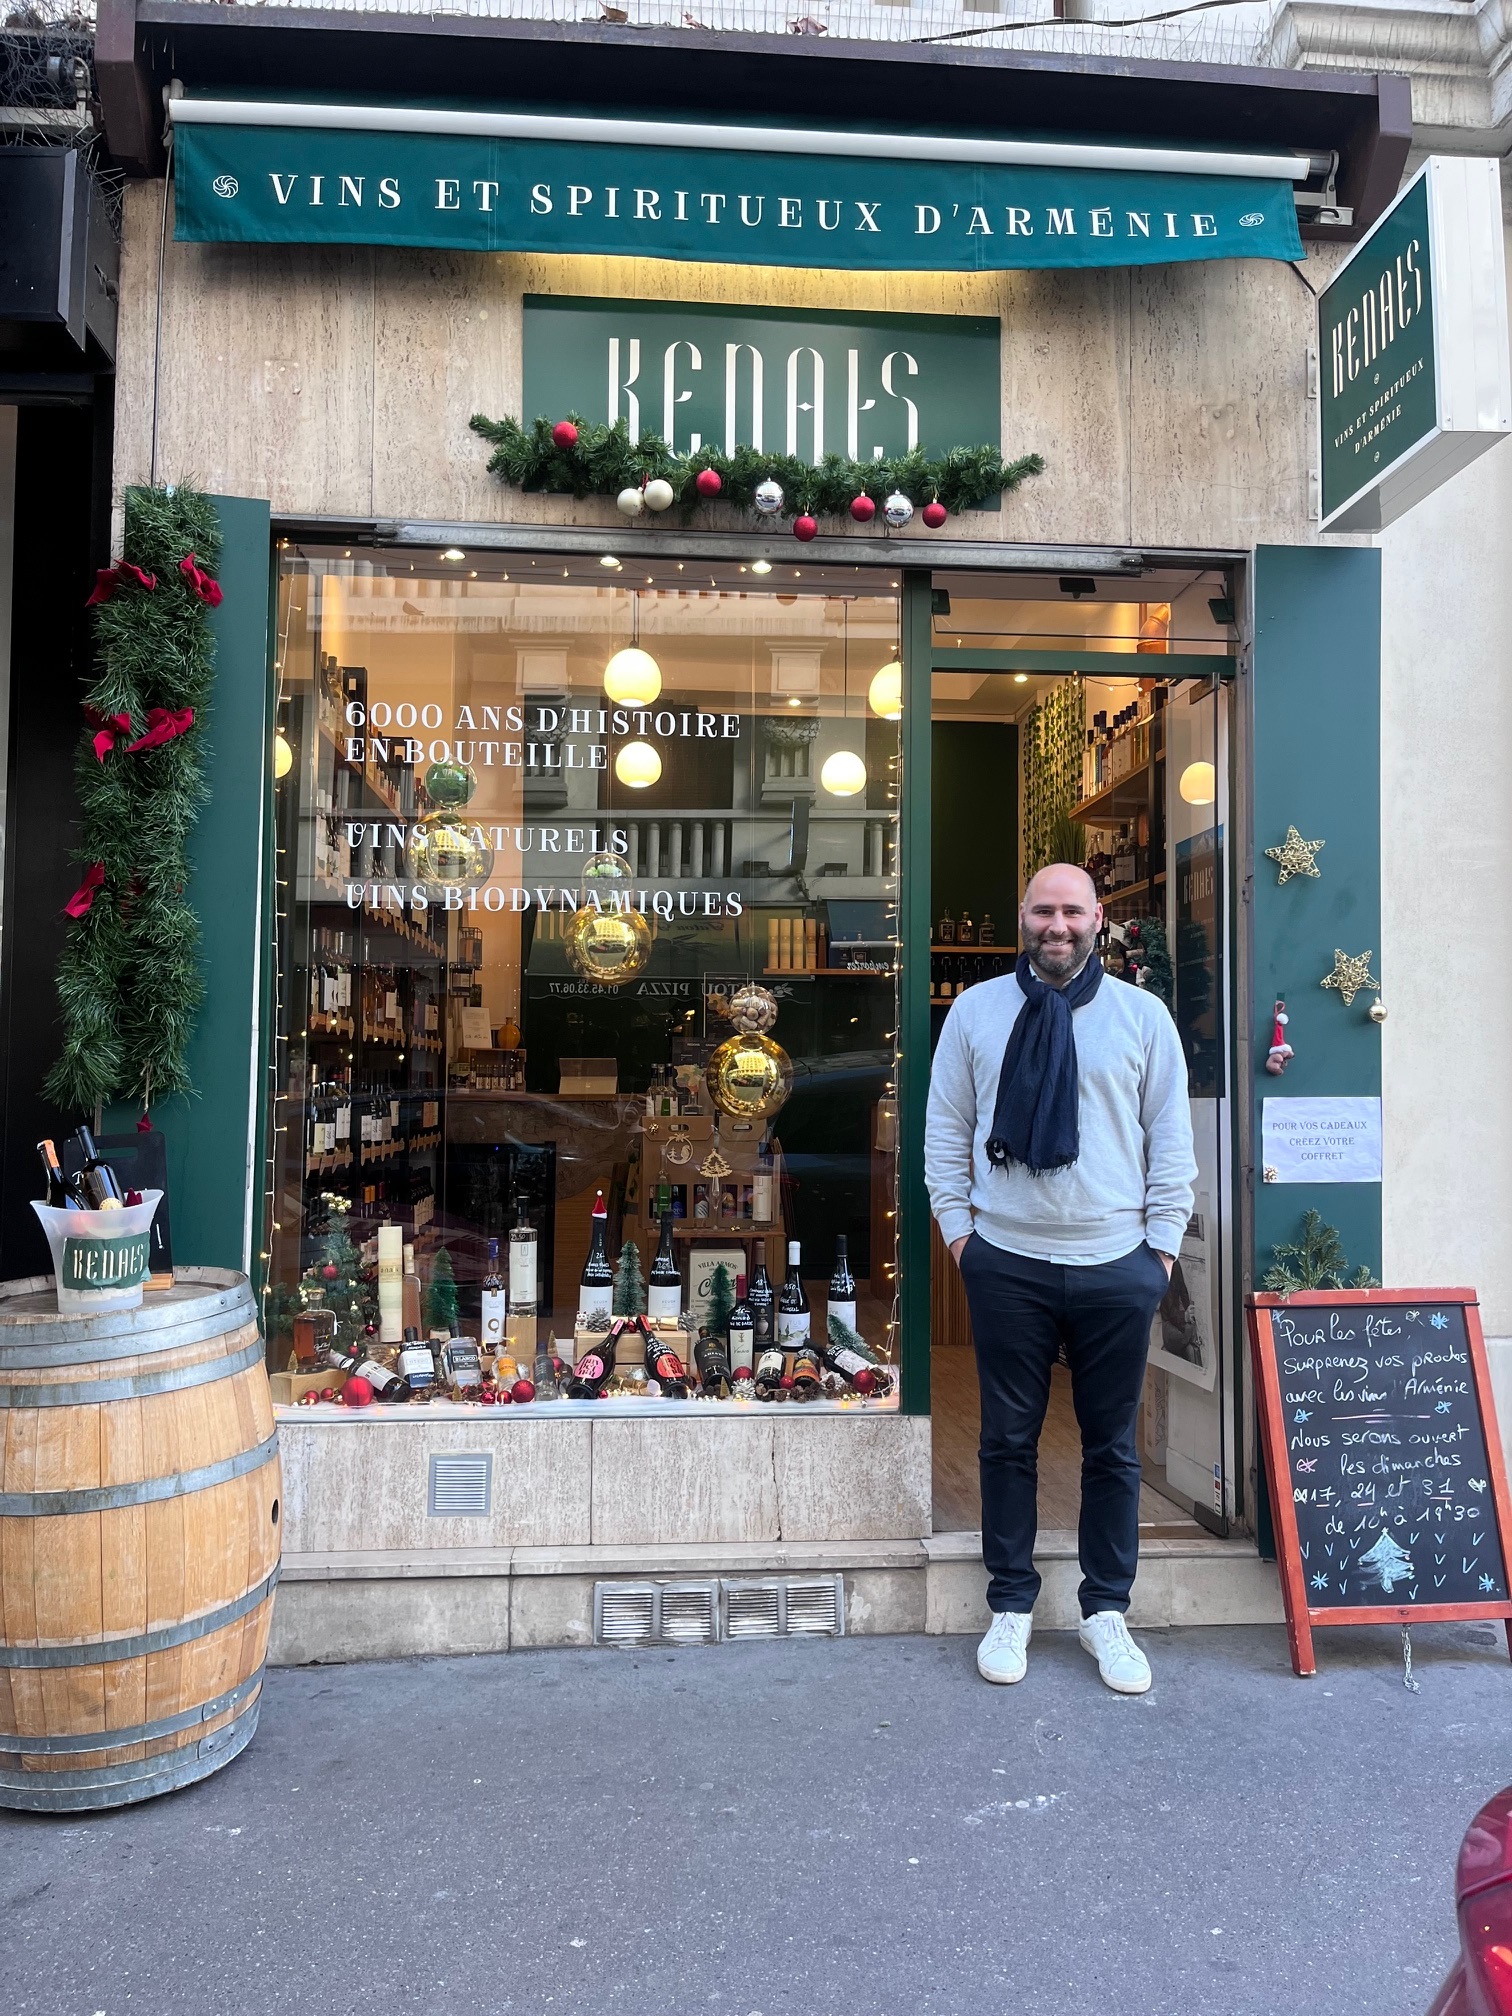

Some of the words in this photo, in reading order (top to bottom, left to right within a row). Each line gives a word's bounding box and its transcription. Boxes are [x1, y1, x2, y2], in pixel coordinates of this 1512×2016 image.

[269, 173, 402, 209] VINS
[435, 179, 500, 212] ET
[529, 183, 882, 233] SPIRITUEUX
[914, 203, 1218, 237] D'ARMÉNIE
[1334, 426, 1354, 449] VINS
[1356, 414, 1367, 431] ET
[1368, 357, 1425, 420] SPIRITUEUX
[345, 701, 444, 730] 6000
[455, 706, 523, 731] ANS
[537, 707, 741, 739] D'HISTOIRE
[344, 737, 400, 763] EN
[404, 739, 608, 770] BOUTEILLE
[344, 822, 428, 849] VINS
[448, 826, 629, 855] NATURELS
[344, 883, 428, 910] VINS
[442, 886, 744, 922] BIODYNAMIQUES
[1272, 1122, 1297, 1131] POUR
[1300, 1121, 1319, 1130] VOS
[1320, 1121, 1368, 1130] CADEAUX
[1323, 1137, 1355, 1146] VOTRE
[1301, 1152, 1343, 1161] COFFRET
[1330, 1313, 1356, 1341] les
[1375, 1354, 1405, 1368] vos
[1285, 1391, 1326, 1404] avec
[1333, 1378, 1355, 1401] les
[1291, 1428, 1331, 1450] Nous
[1341, 1430, 1402, 1446] serons
[1408, 1424, 1470, 1444] ouvert
[1340, 1453, 1366, 1475] les
[1372, 1447, 1462, 1475] dimanches
[1351, 1481, 1376, 1502] 24
[1385, 1475, 1412, 1499] et
[1421, 1478, 1455, 1496] 31
[1325, 1515, 1346, 1535] de
[1394, 1505, 1407, 1526] à
